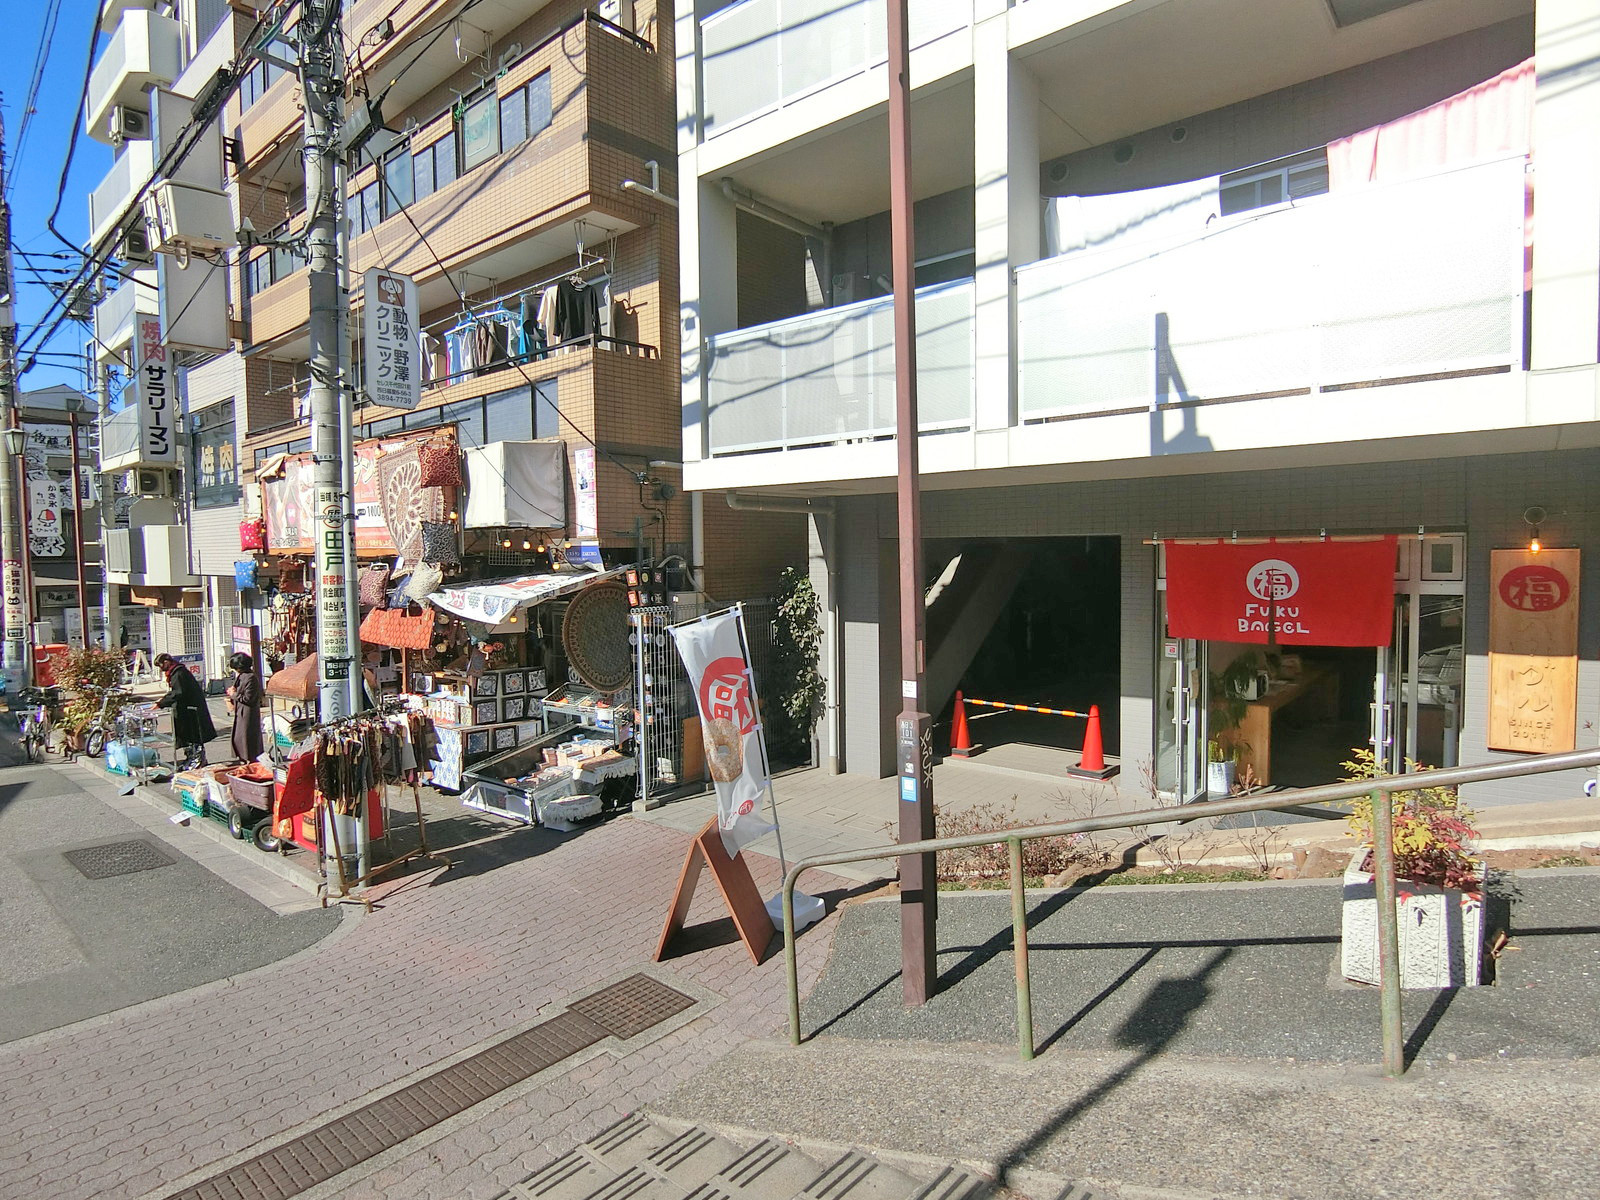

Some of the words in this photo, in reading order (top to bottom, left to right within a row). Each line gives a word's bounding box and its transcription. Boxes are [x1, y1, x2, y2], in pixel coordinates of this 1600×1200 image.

[142, 320, 166, 363] 焼肉
[376, 304, 392, 378] クリニック
[392, 307, 409, 382] 動物・野澤
[145, 365, 169, 455] サラリーマン
[376, 394, 412, 404] 3894-7739
[202, 440, 234, 488] 焼肉
[47, 485, 58, 508] かき氷
[1256, 569, 1289, 597] 福
[1509, 719, 1552, 729] SINCE
